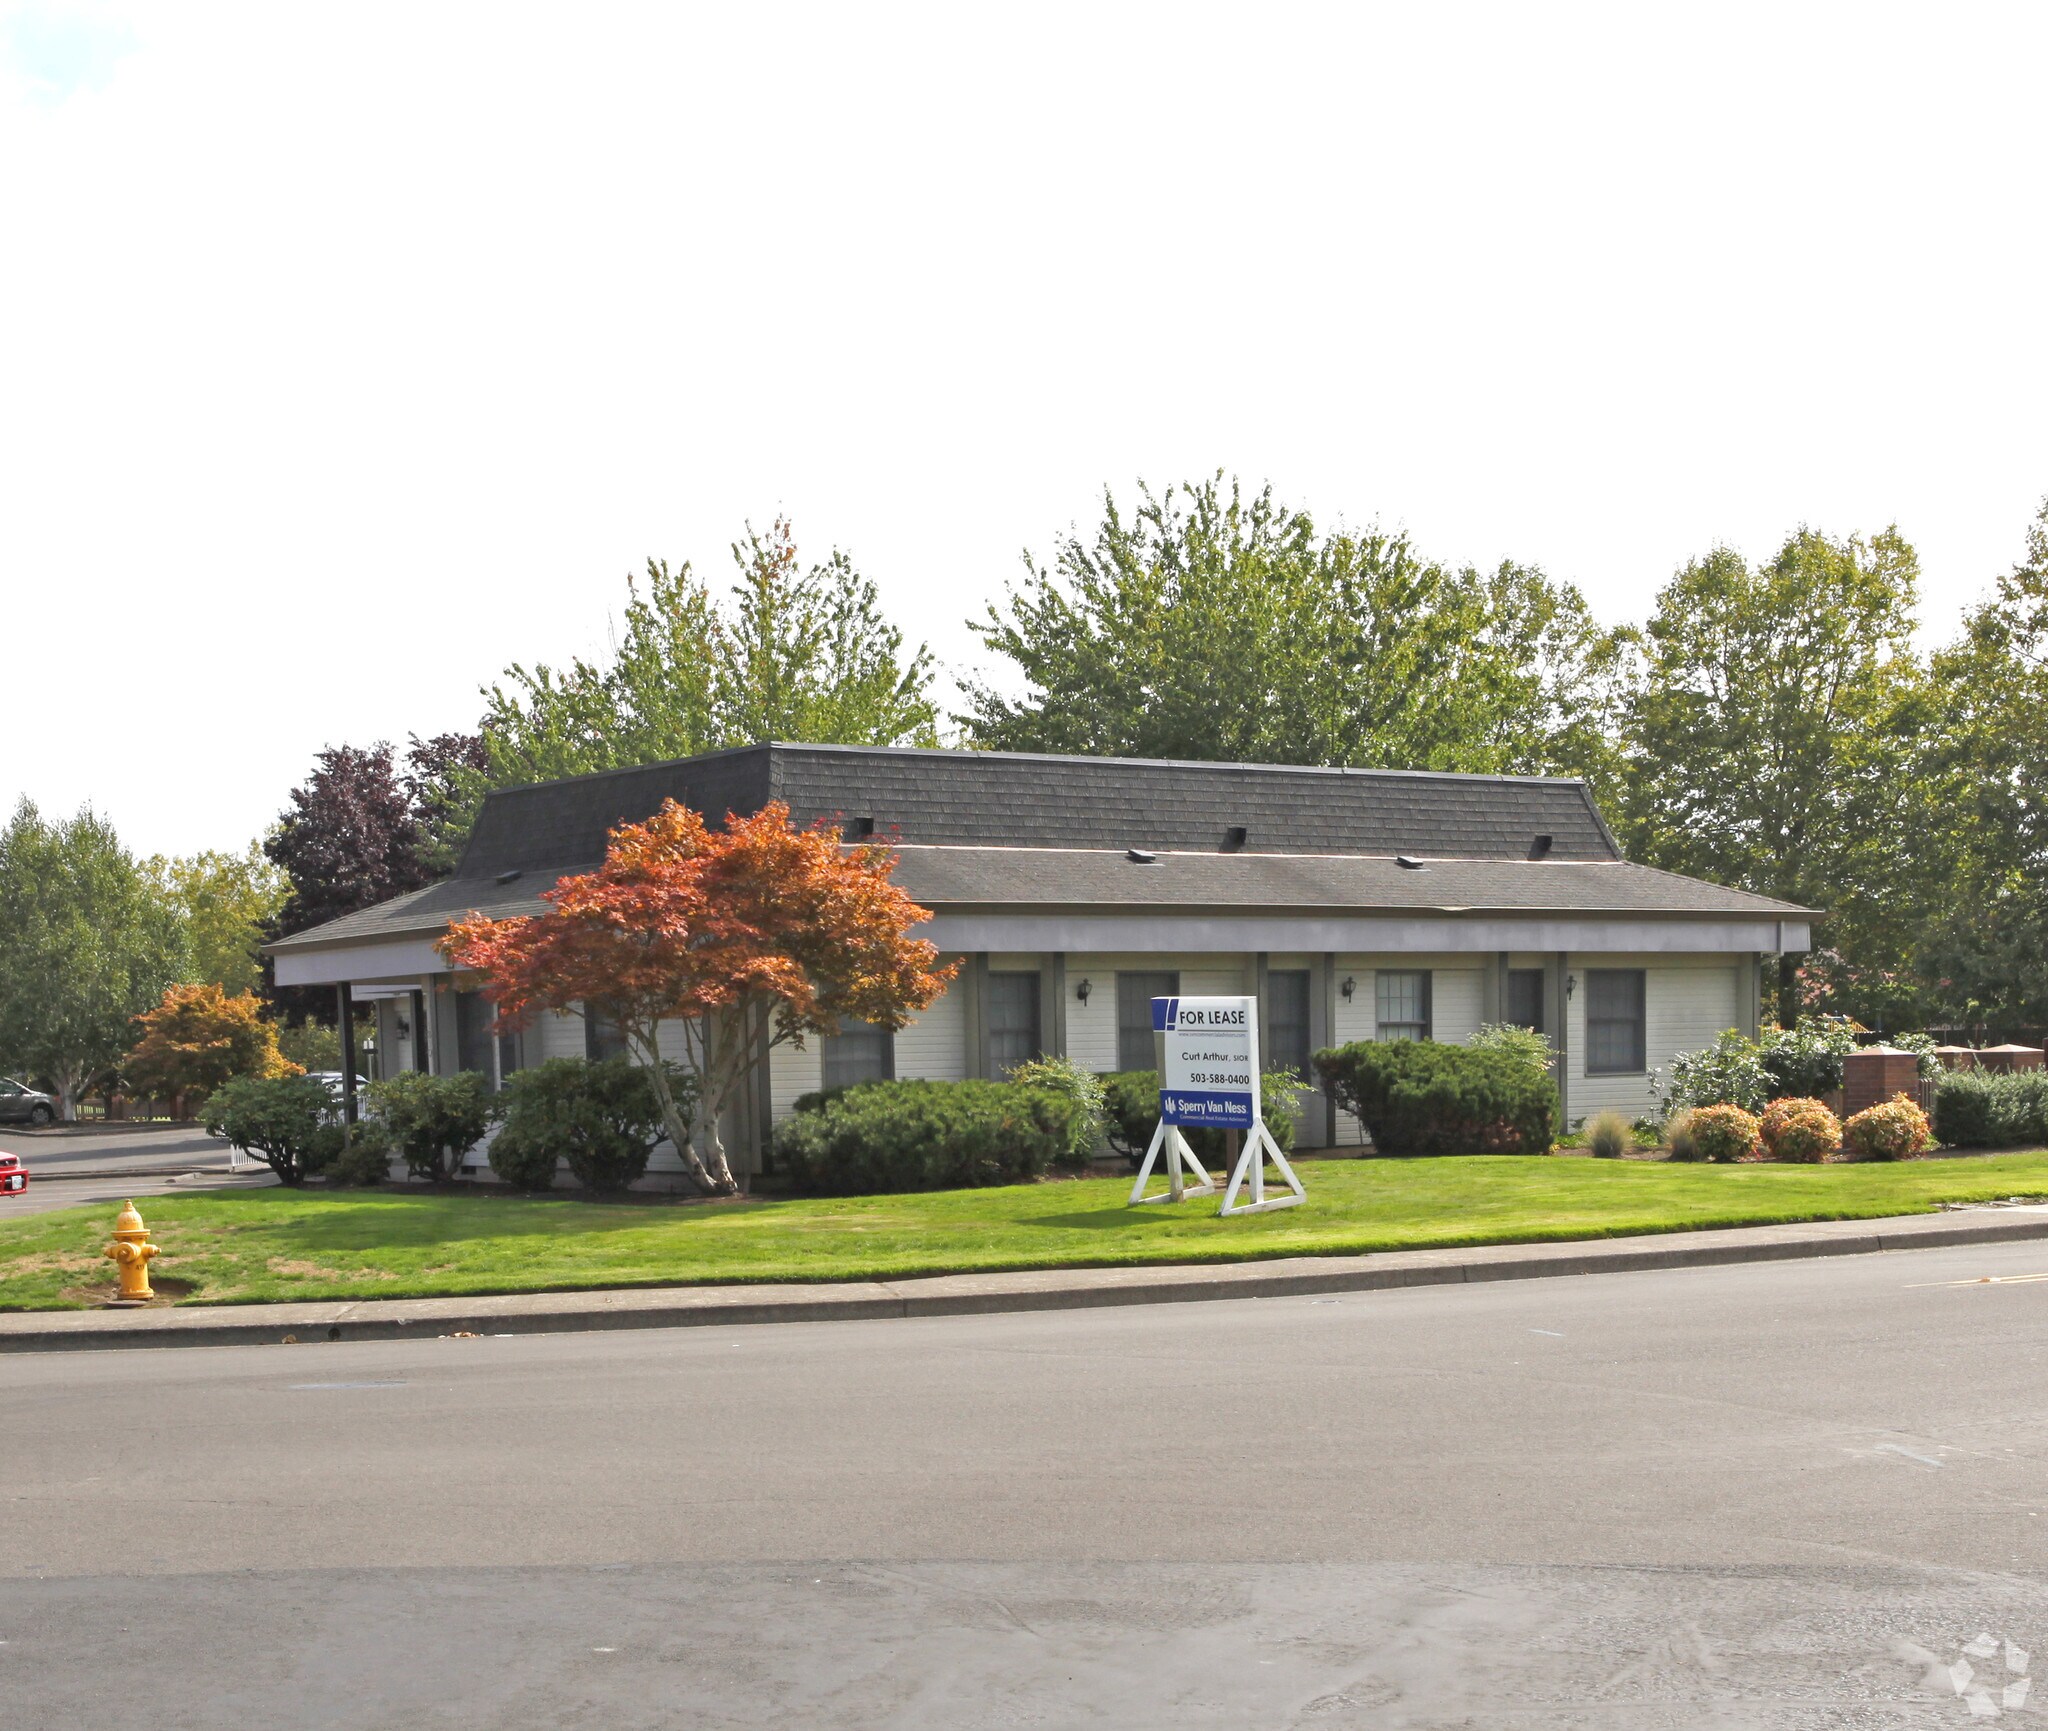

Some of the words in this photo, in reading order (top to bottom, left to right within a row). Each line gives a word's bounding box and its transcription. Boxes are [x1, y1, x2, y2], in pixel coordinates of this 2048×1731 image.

[1180, 1011, 1204, 1024] FOR
[1209, 1011, 1244, 1024] LEASE
[1182, 1052, 1200, 1061] Curt
[1203, 1052, 1231, 1062] Arthur,
[1190, 1073, 1249, 1084] 503-588-0400
[1178, 1099, 1205, 1114] Sperry
[1207, 1100, 1223, 1113] Van
[1225, 1101, 1246, 1114] Ness
